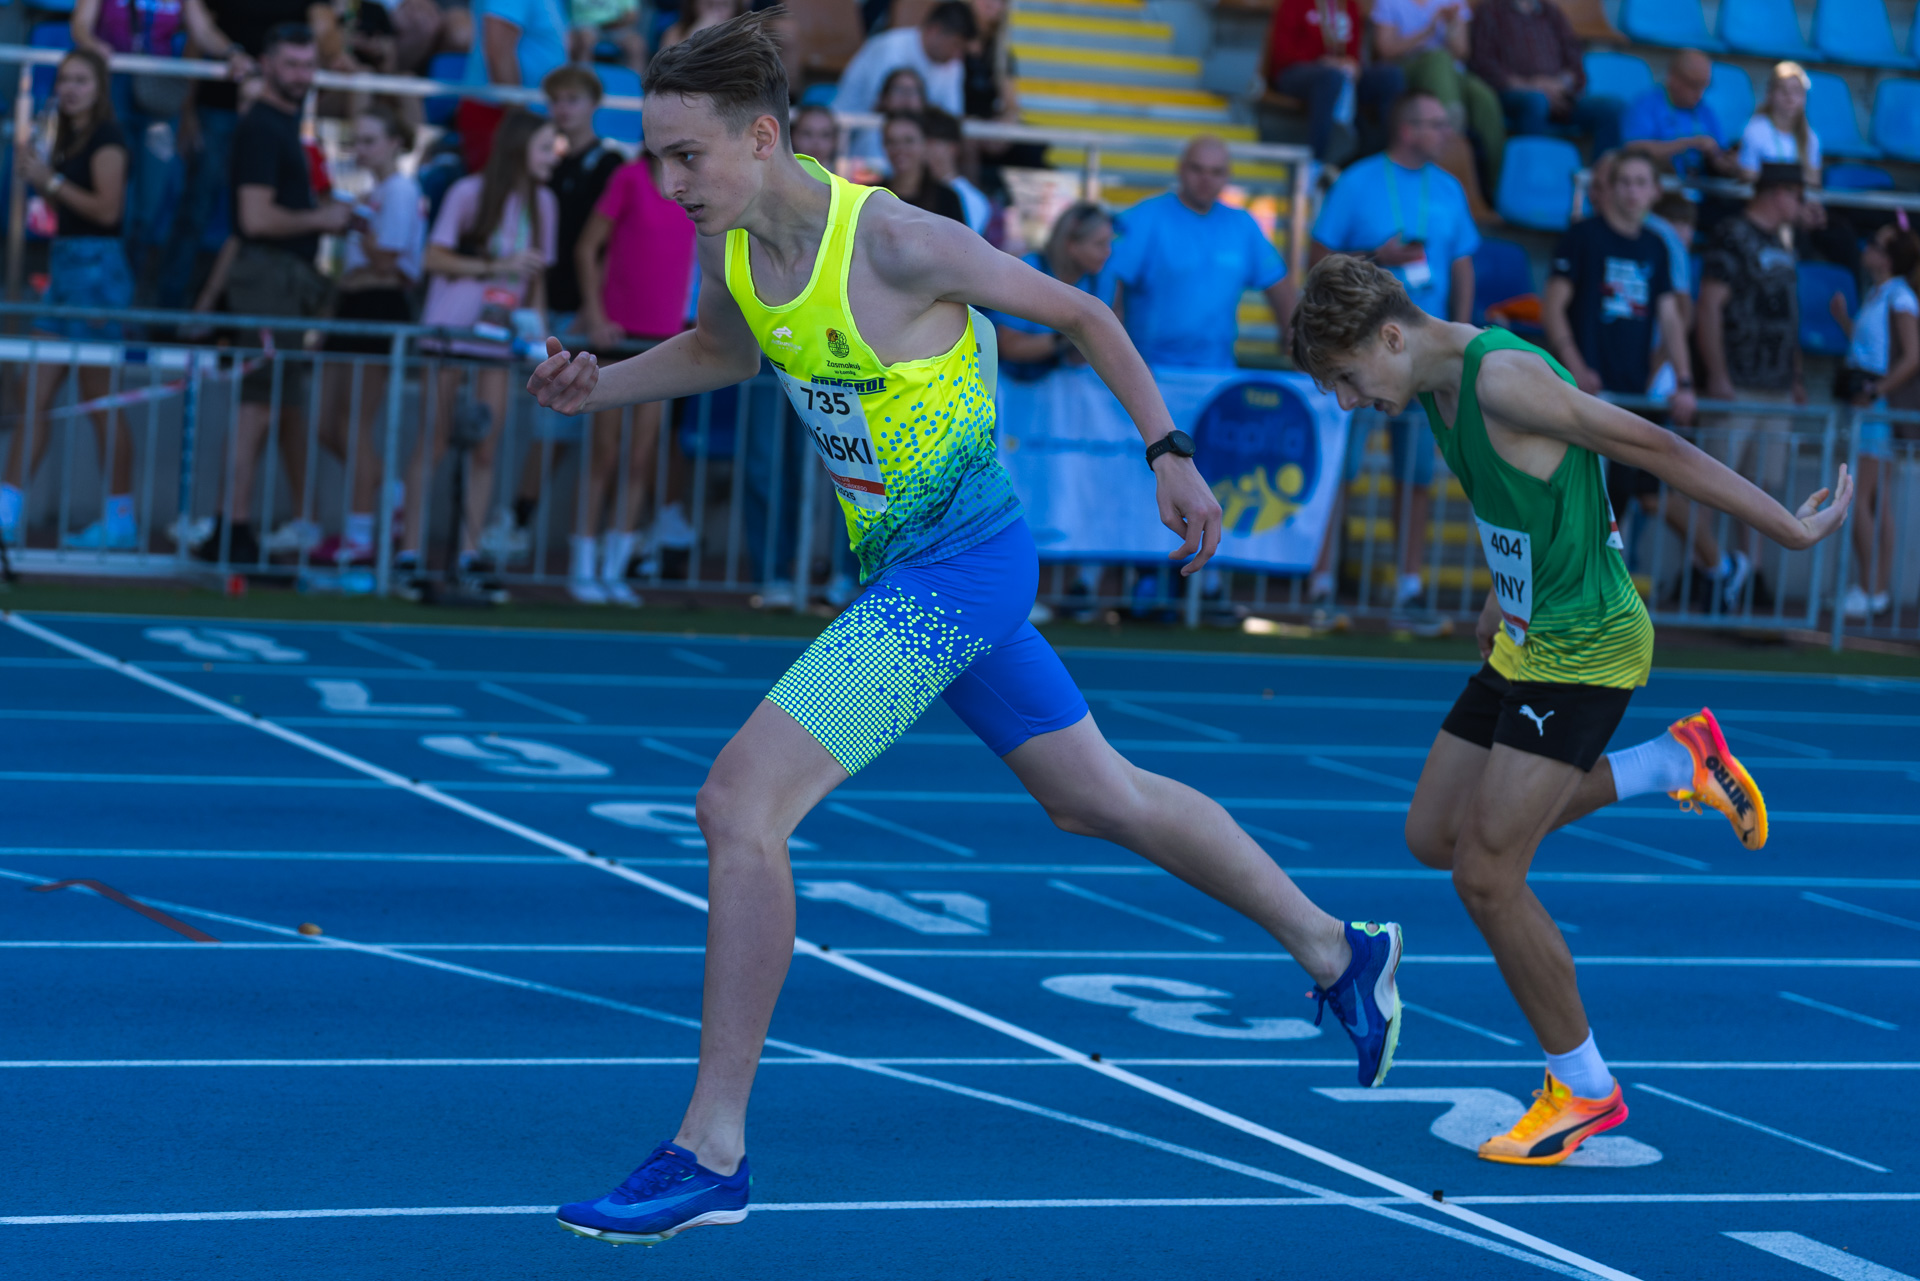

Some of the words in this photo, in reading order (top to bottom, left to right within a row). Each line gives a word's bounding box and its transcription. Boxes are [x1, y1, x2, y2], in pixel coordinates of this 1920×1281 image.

[826, 360, 861, 371] Zasmakuj
[800, 386, 850, 415] 735
[806, 423, 873, 465] ŃSKI
[1491, 532, 1523, 560] 404
[1705, 755, 1755, 821] NITRO
[1040, 973, 1322, 1041] 3
